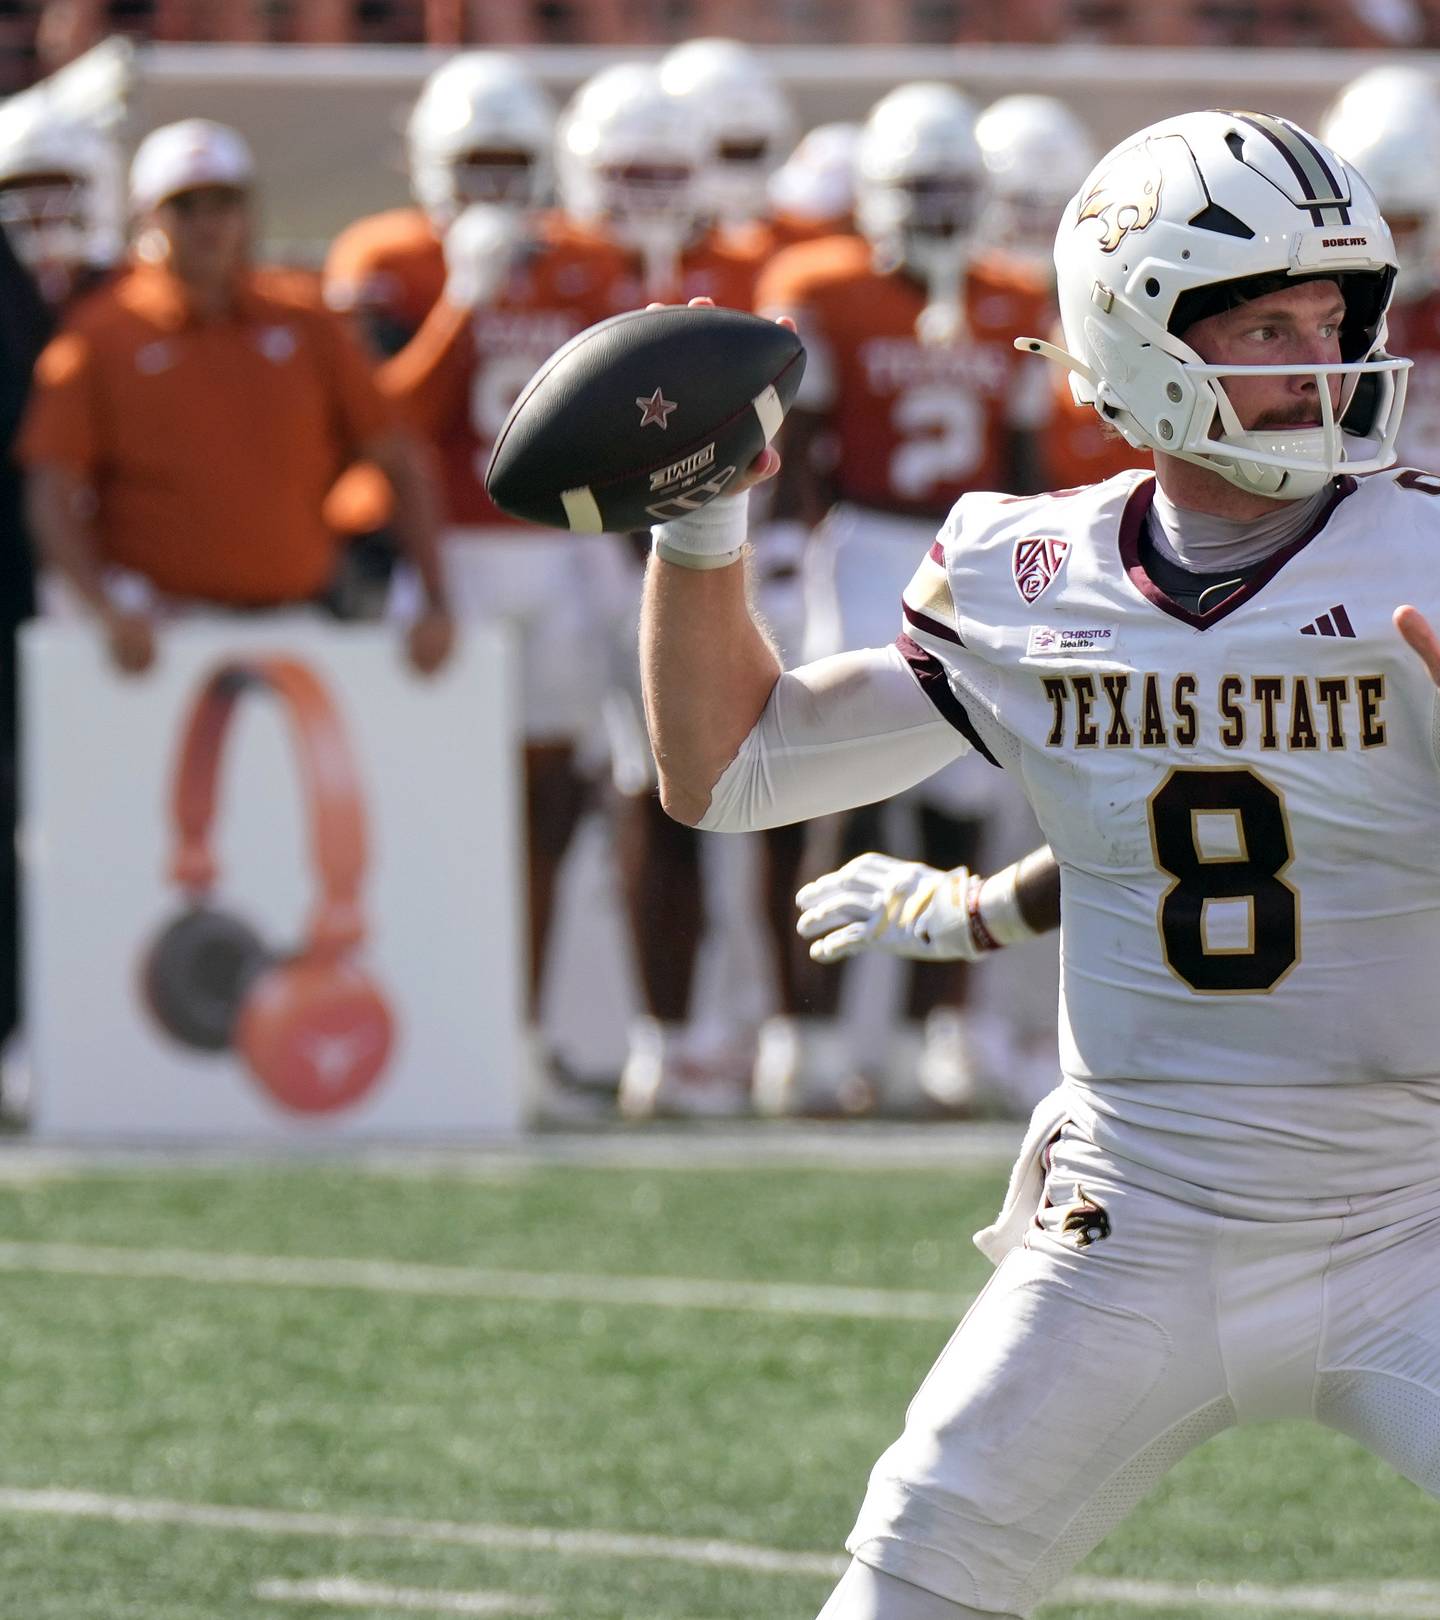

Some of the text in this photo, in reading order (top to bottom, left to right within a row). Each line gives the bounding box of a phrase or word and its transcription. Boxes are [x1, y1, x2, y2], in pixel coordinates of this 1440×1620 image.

[1322, 237, 1367, 248] BOBCATS
[1015, 538, 1068, 578] PAC
[1025, 580, 1040, 593] 12
[1062, 629, 1111, 640] CHRISTUS
[1039, 672, 1388, 752] TEXAS STATE
[1145, 763, 1302, 995] 8
